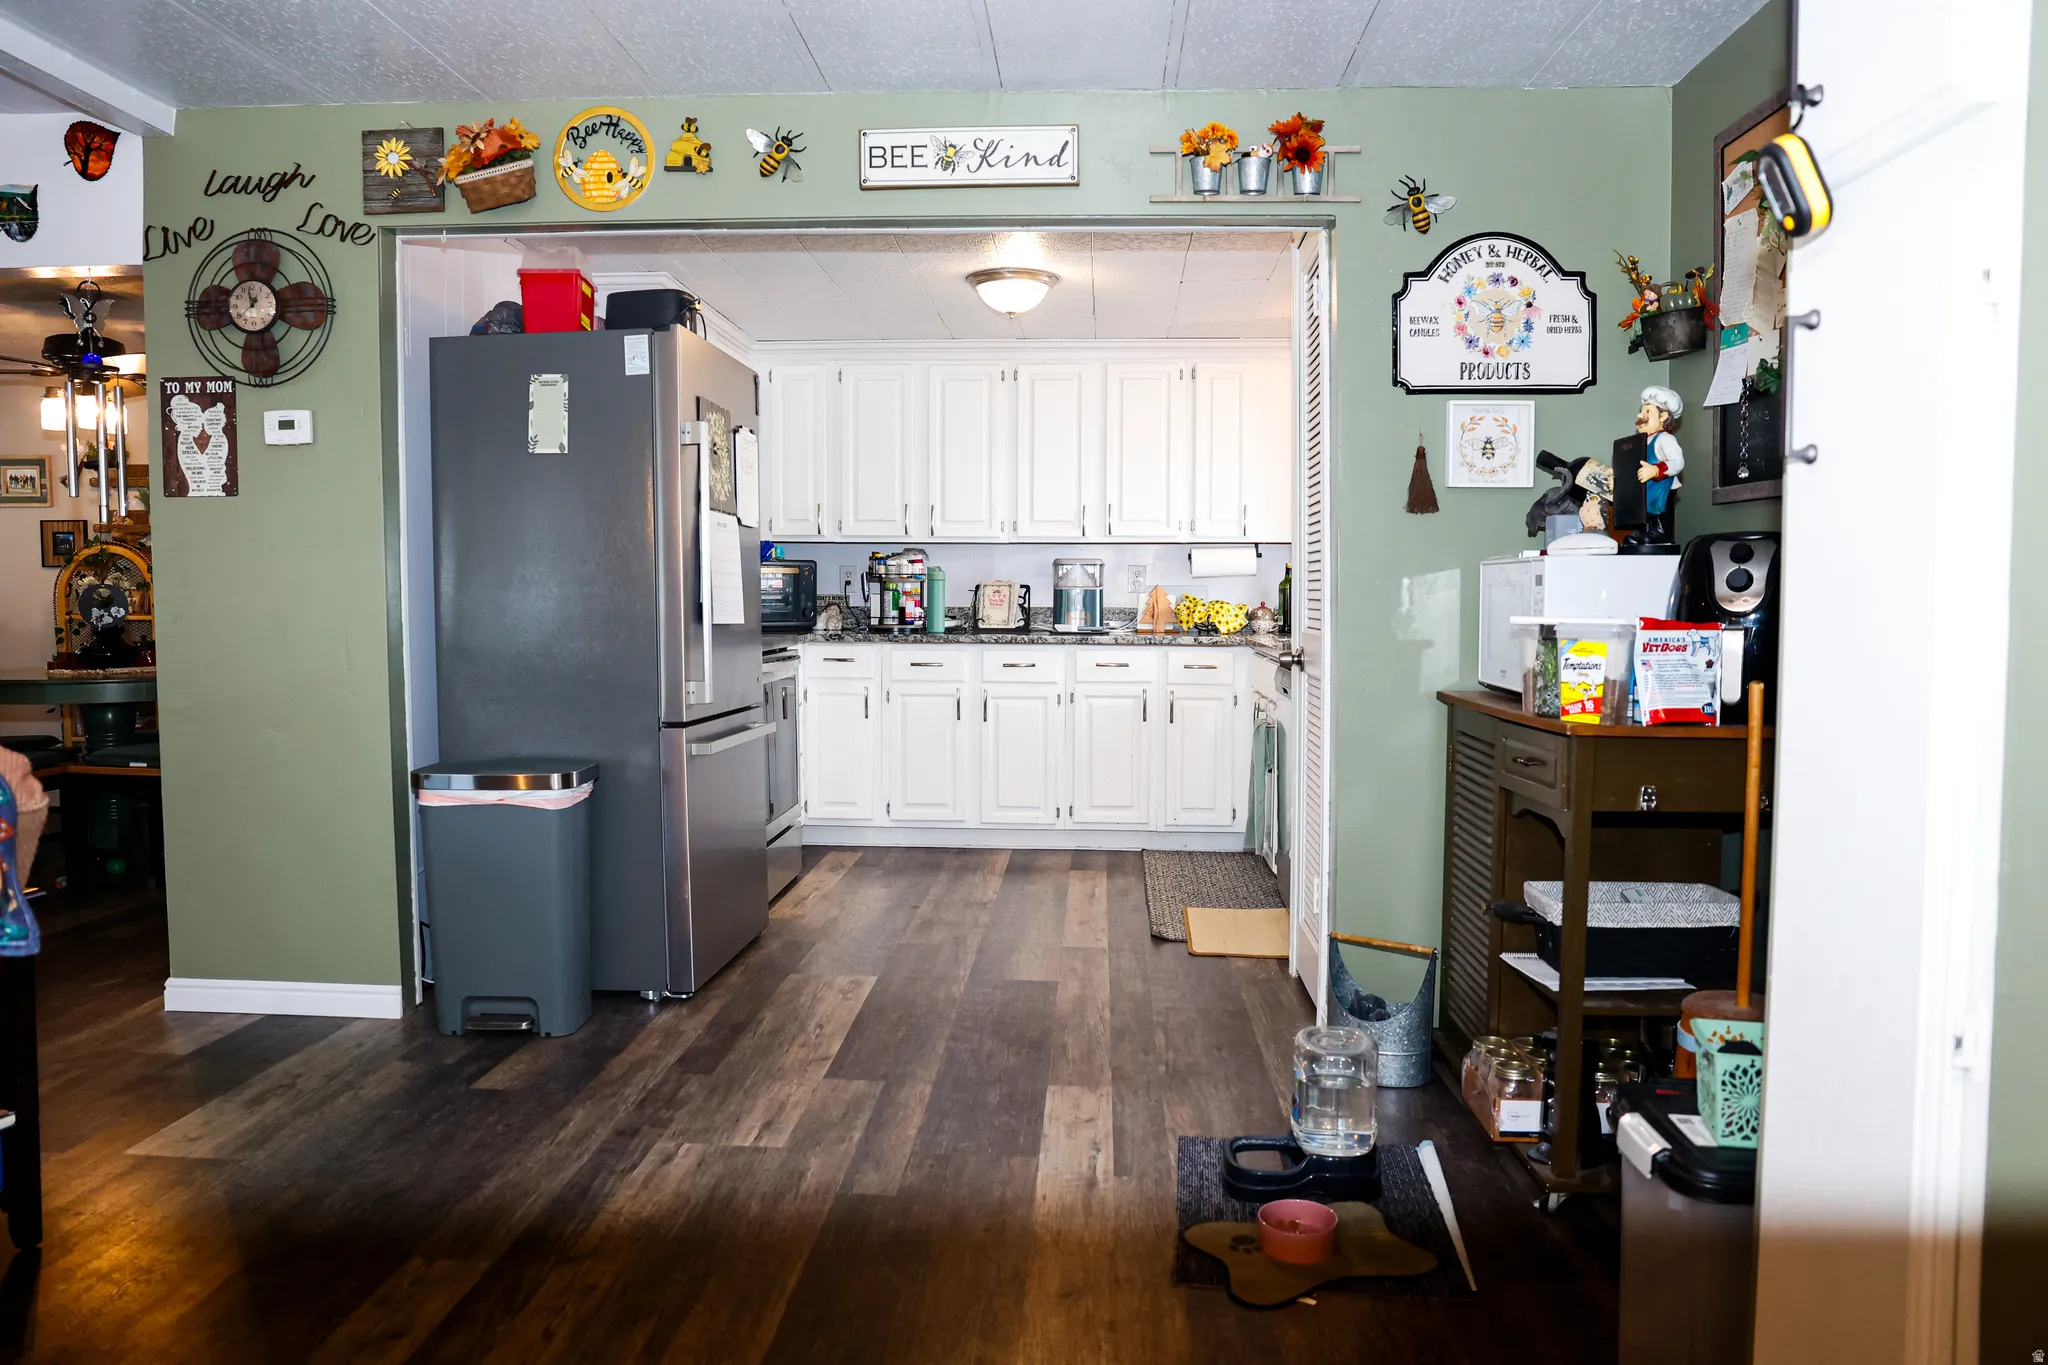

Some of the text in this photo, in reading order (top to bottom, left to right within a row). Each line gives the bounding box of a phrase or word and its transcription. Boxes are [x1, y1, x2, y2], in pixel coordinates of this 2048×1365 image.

[566, 114, 648, 154] Bee Happy
[868, 137, 1069, 174] BEE Kind
[203, 161, 316, 202] Laugh
[296, 202, 376, 246] Love
[143, 216, 214, 262] Live
[1437, 244, 1554, 284] HONEY & HERBAL
[1409, 316, 1440, 325] BEEWAX
[1549, 314, 1578, 324] FRESH &
[1409, 328, 1440, 338] CANDLES
[1546, 326, 1582, 334] DRIED HERBS
[1459, 362, 1531, 380] PRODUCTS
[164, 380, 233, 394] TO MY MOM
[1562, 657, 1602, 672] Temptations
[1583, 700, 1594, 709] 16
